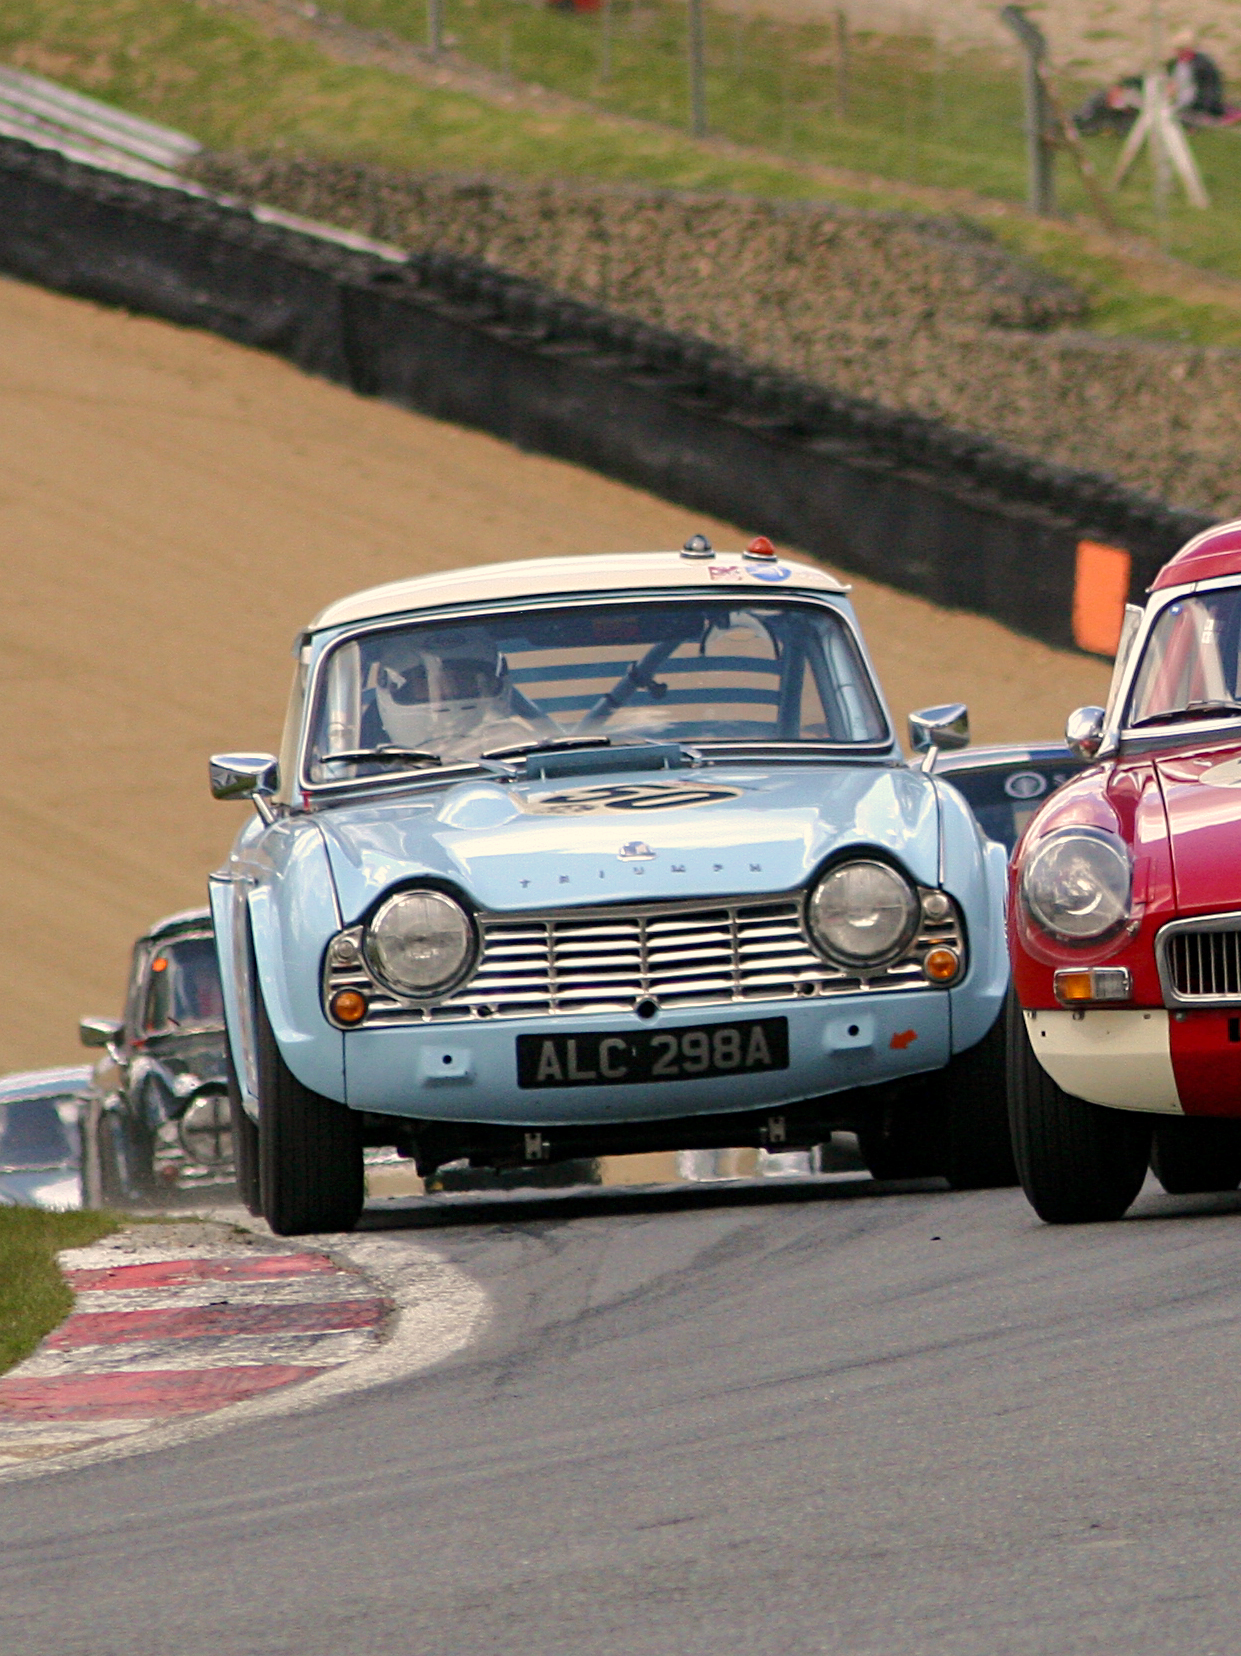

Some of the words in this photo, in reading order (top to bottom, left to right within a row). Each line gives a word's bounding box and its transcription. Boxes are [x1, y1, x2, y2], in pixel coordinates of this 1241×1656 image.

[519, 862, 762, 889] TRIUMPH
[537, 1037, 629, 1082] ALC
[650, 1024, 773, 1076] 298A
